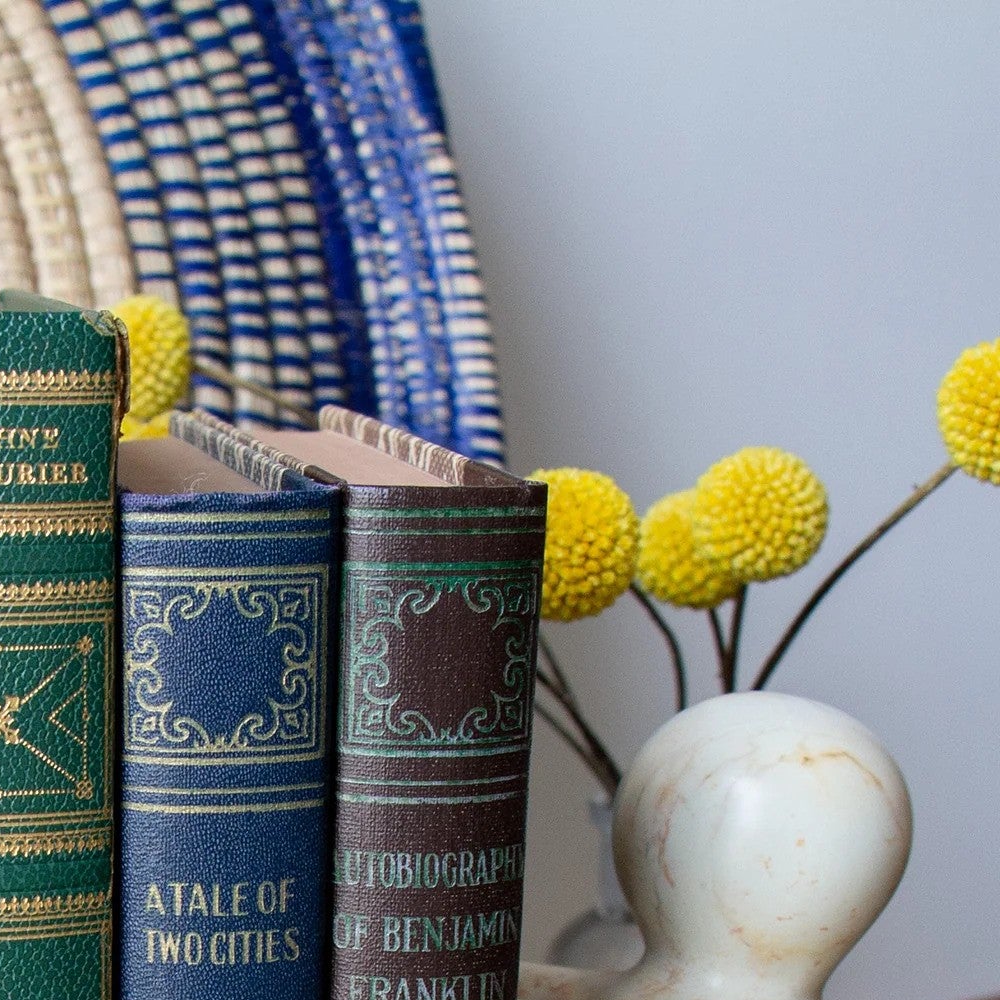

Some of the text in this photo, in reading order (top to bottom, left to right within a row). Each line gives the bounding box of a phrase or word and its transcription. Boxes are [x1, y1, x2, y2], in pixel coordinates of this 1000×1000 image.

[145, 878, 296, 917] A TALE OF
[143, 927, 300, 965] TWO CITIES
[332, 905, 521, 952] OF BENJAMIN
